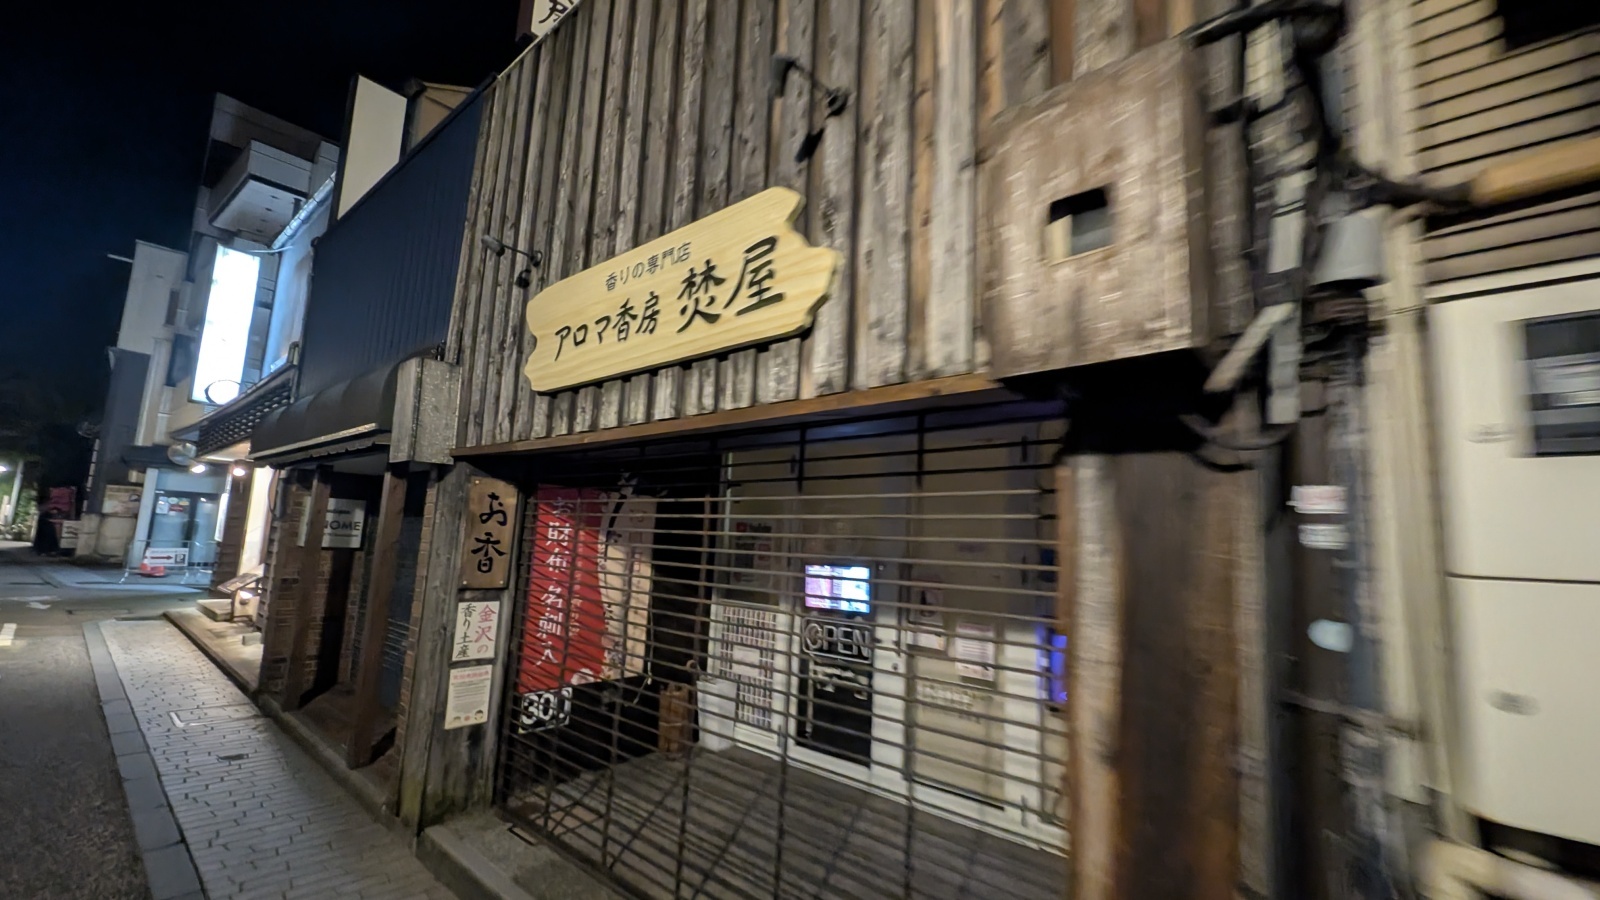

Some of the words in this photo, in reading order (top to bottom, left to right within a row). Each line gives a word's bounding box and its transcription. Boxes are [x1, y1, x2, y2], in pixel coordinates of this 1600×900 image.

[605, 242, 691, 290] 香りの専門店
[555, 291, 660, 361] アロマ香房
[677, 235, 786, 334] 焚屋
[471, 492, 507, 573] お香
[455, 603, 476, 658] 香り土産
[474, 605, 496, 653] 金沢の
[804, 623, 871, 658] OPEN
